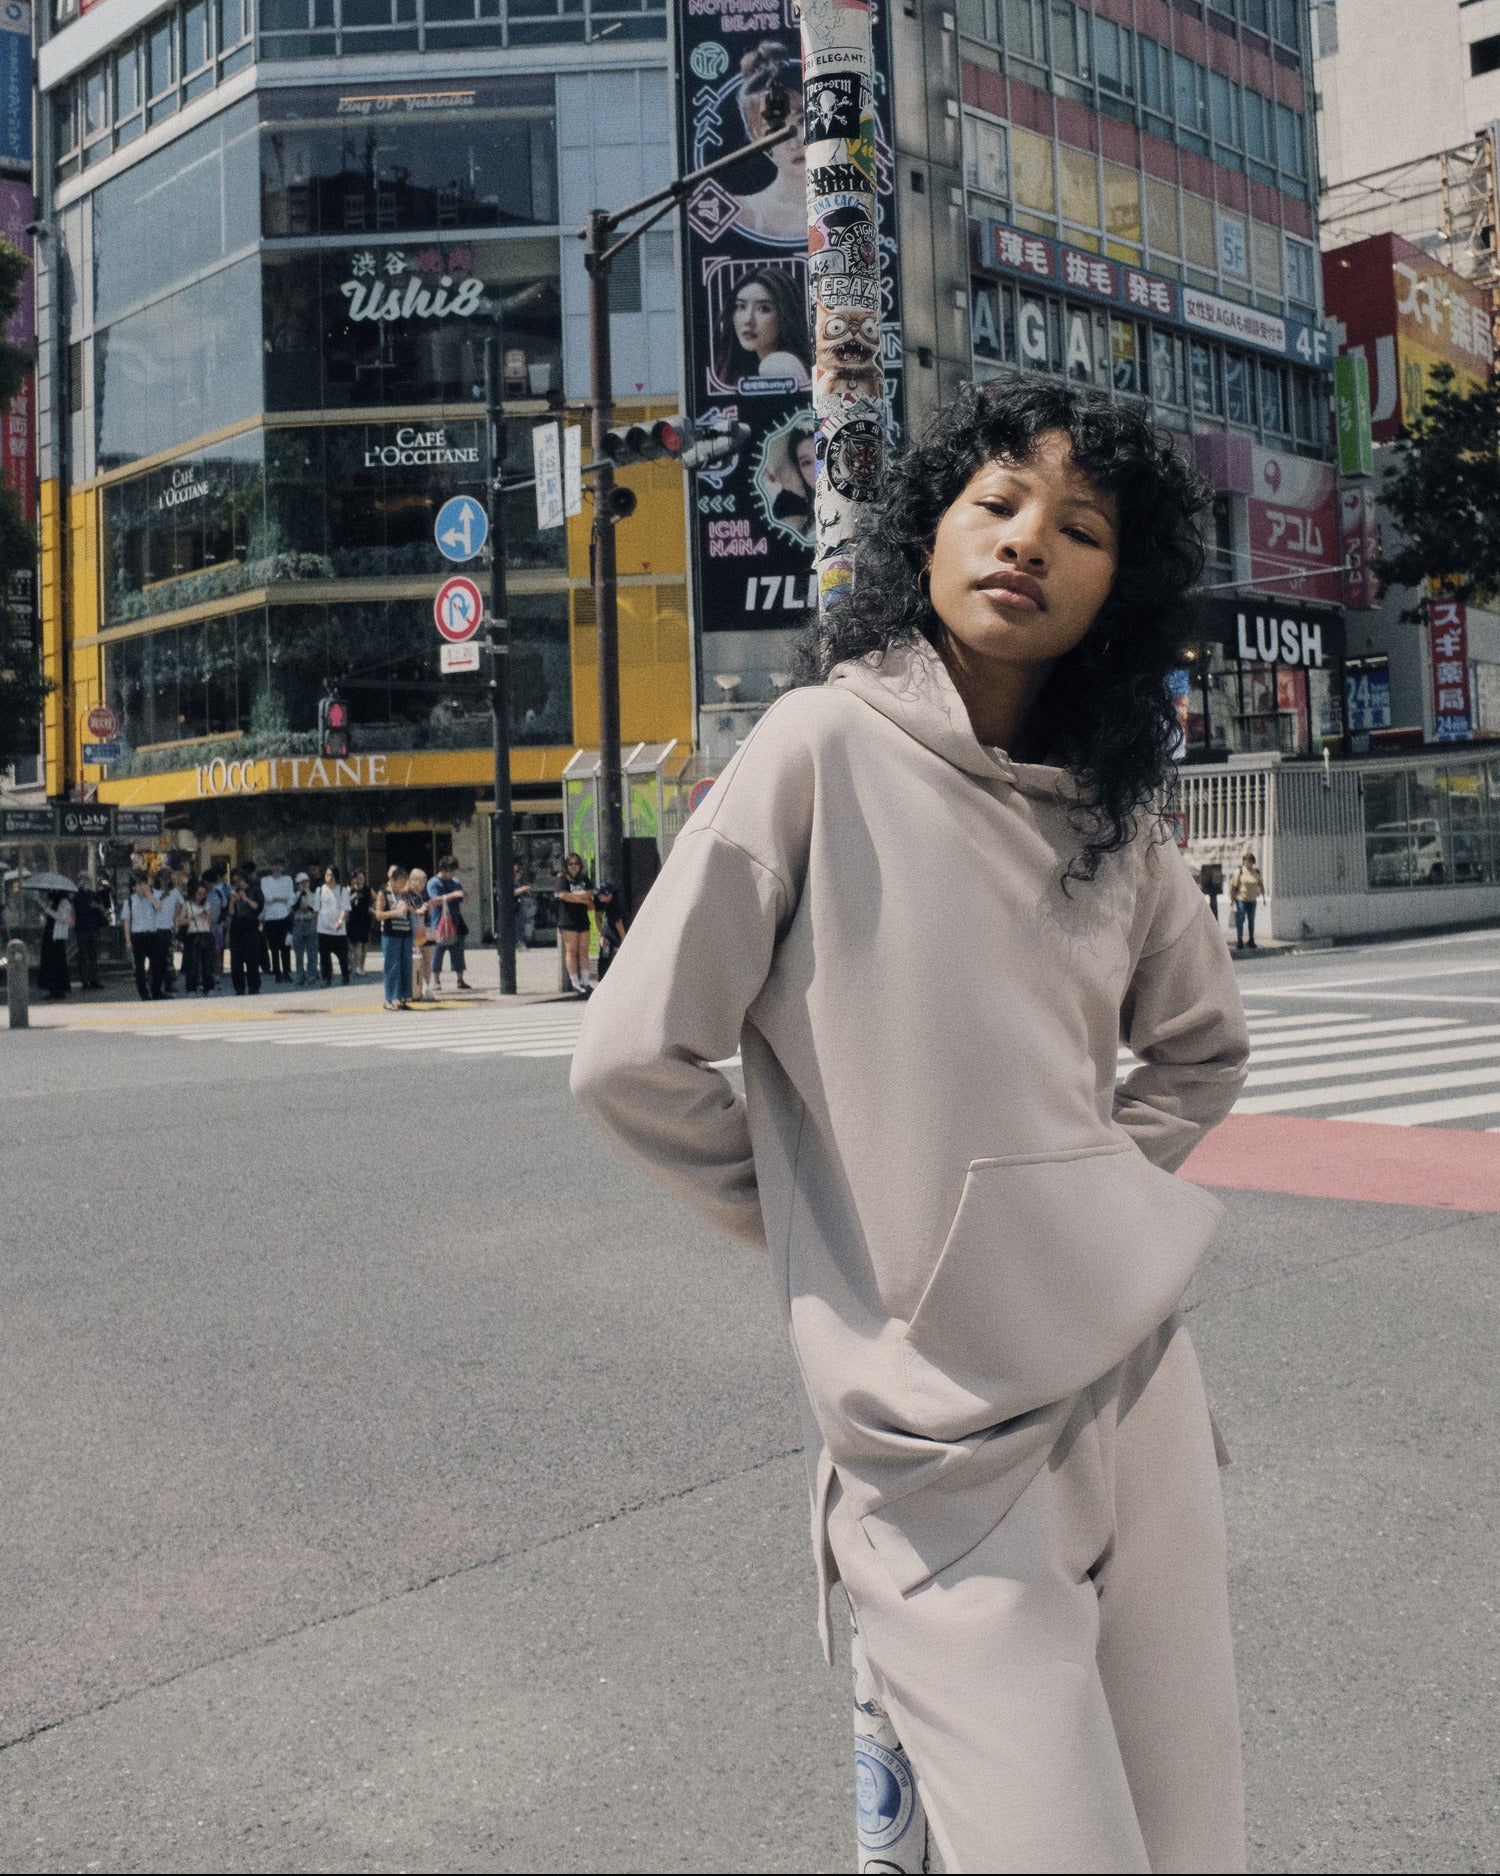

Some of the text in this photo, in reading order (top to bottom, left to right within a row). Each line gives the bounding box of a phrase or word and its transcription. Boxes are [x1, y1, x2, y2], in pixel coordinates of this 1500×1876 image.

[1296, 326, 1327, 366] 4F
[709, 537, 768, 557] NANA
[1237, 613, 1322, 667] LUSH
[1433, 603, 1465, 711] スギ薬局
